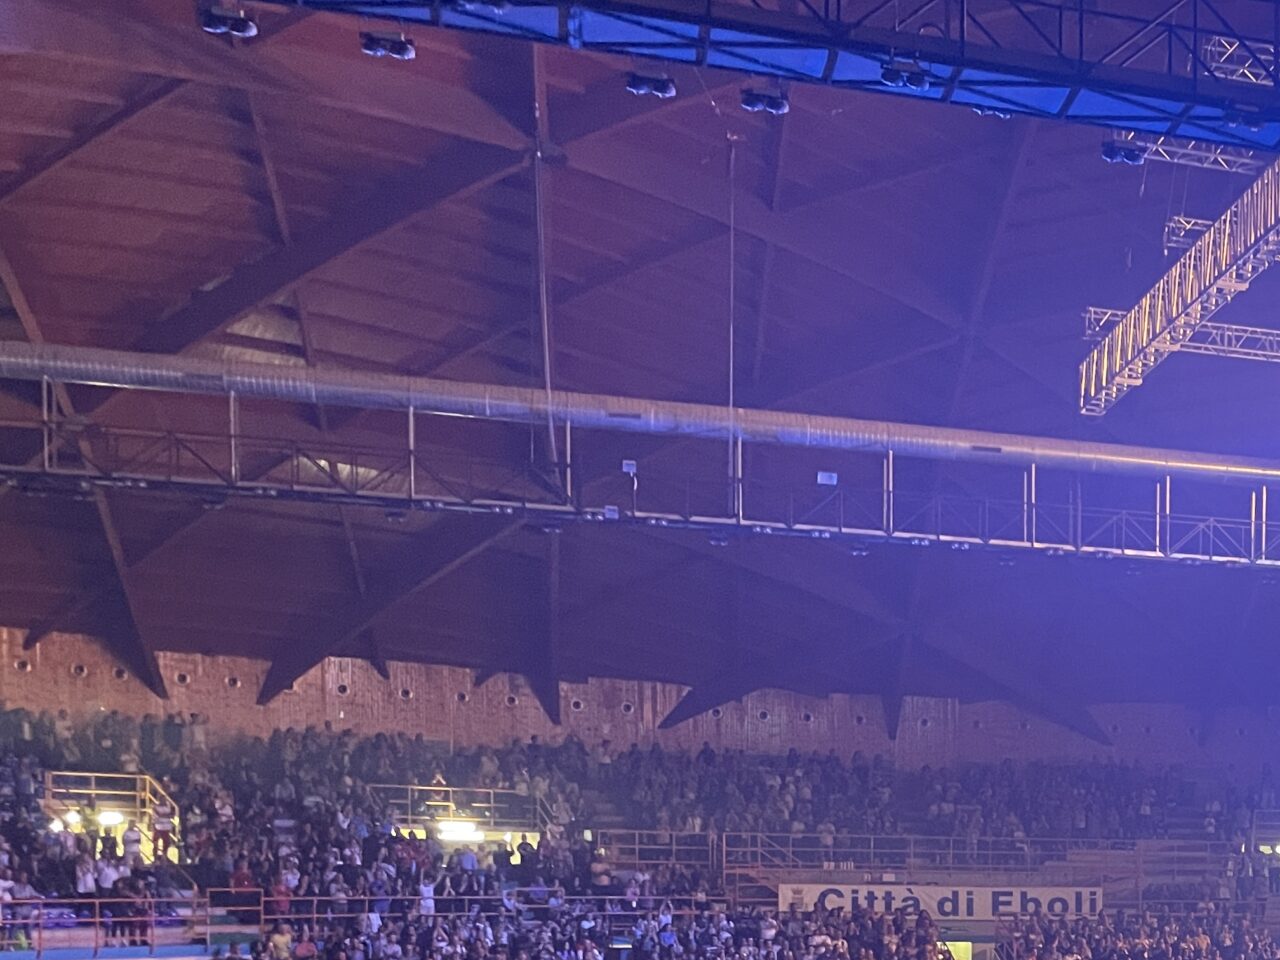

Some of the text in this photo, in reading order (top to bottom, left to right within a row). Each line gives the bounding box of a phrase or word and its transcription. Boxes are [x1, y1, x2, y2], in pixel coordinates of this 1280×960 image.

[817, 888, 1097, 917] Città di Eboli
